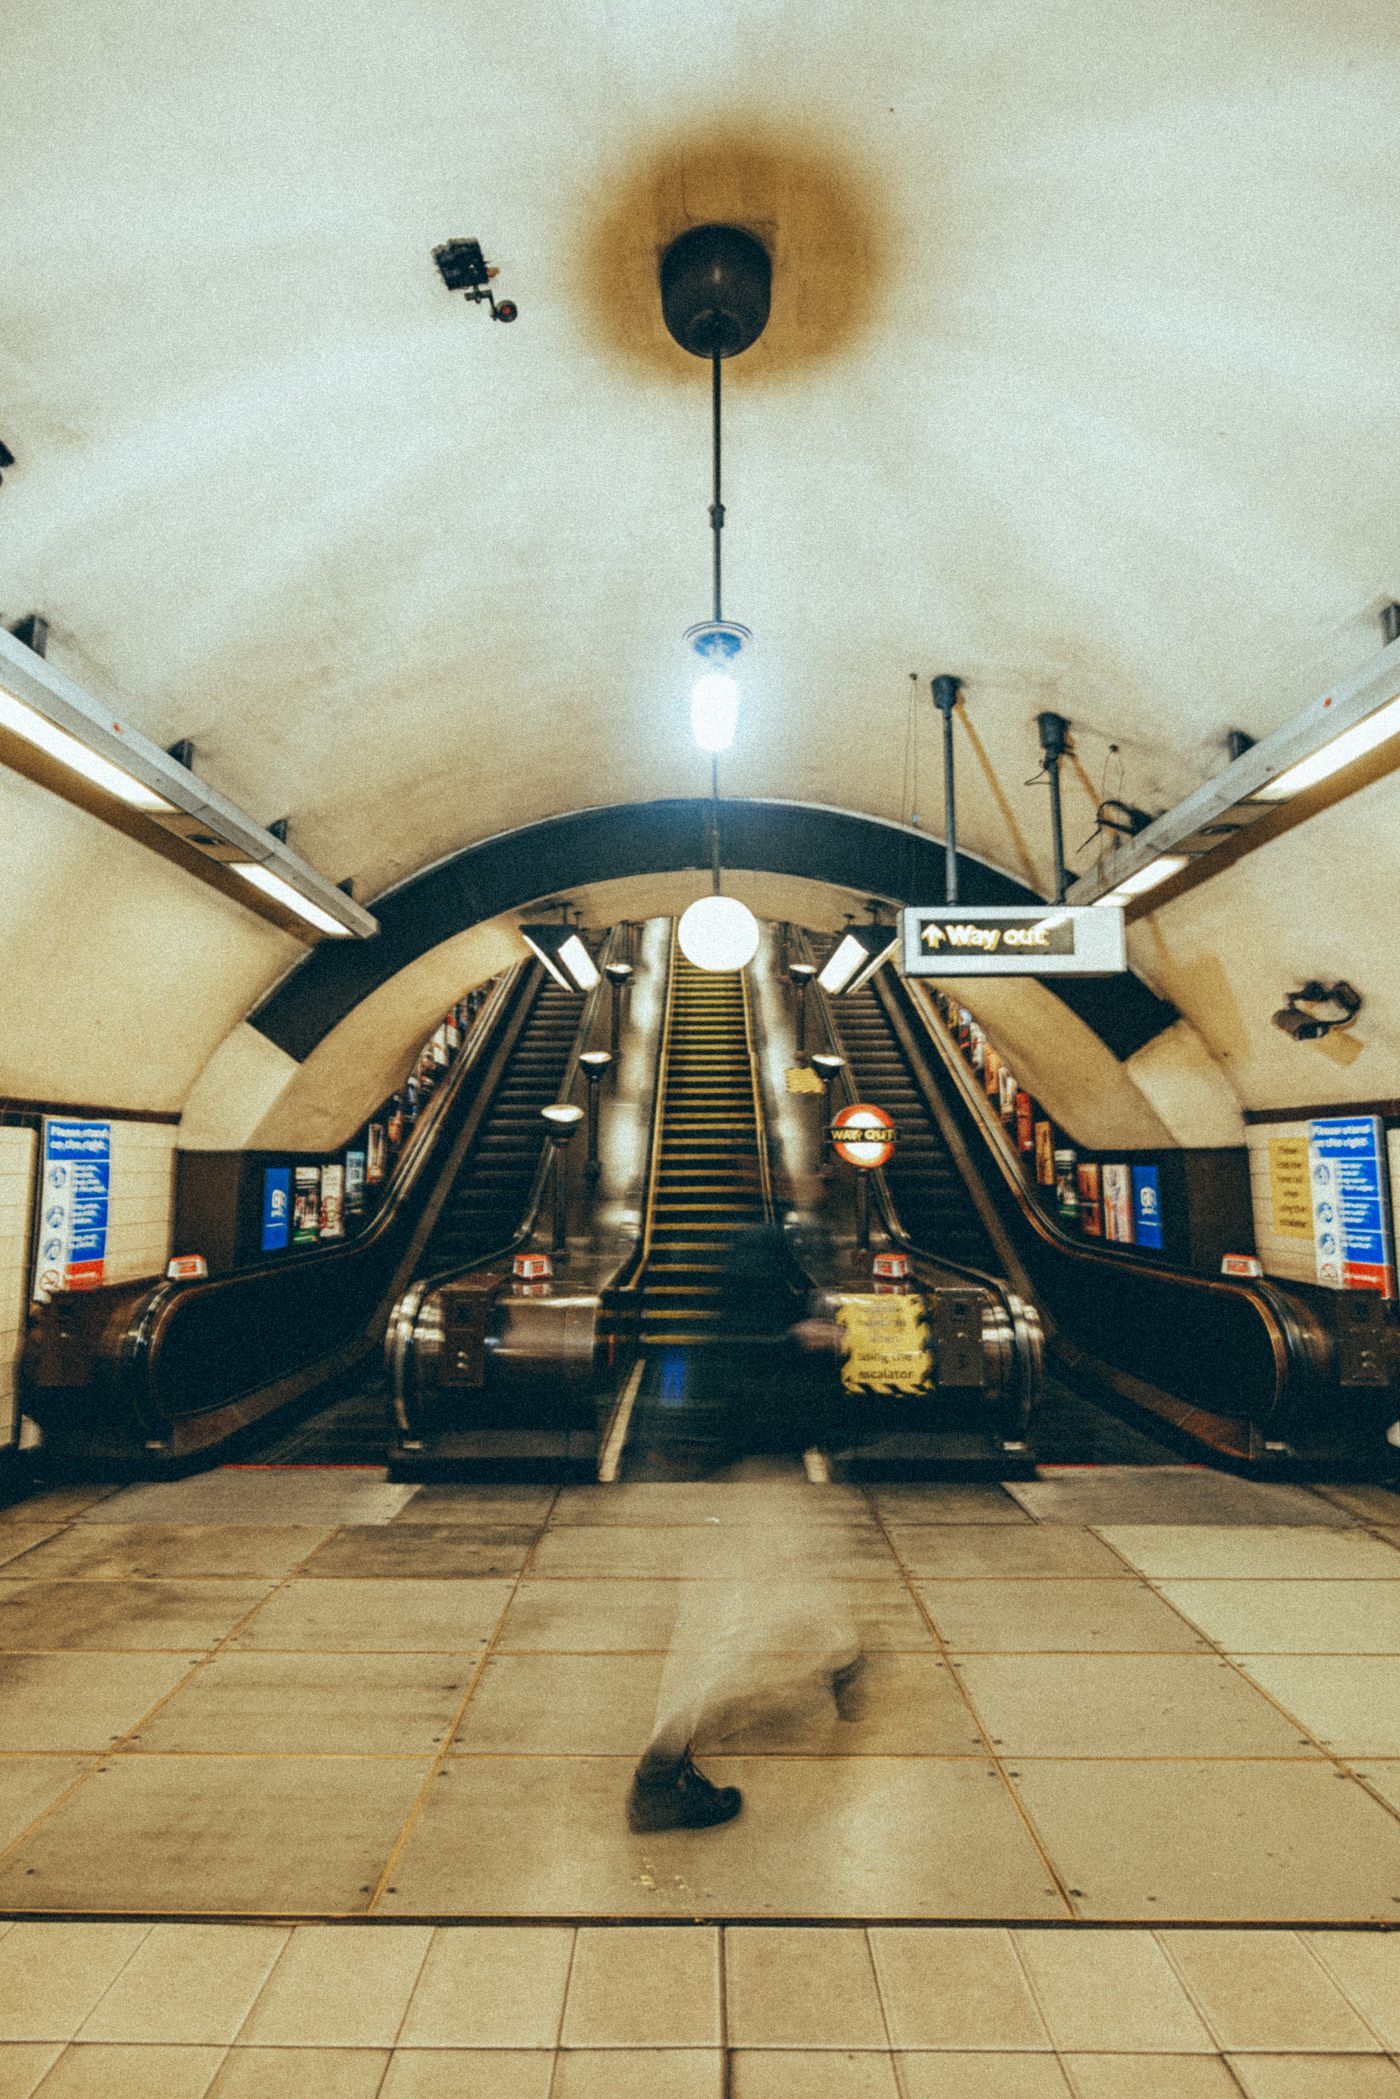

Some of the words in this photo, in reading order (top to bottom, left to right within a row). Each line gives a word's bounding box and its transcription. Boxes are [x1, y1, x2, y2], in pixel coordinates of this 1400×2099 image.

[944, 924, 1001, 951] Way
[1003, 928, 1050, 947] out
[831, 1129, 862, 1141] WAY
[864, 1129, 895, 1141] OUT
[859, 1370, 912, 1379] escalator
